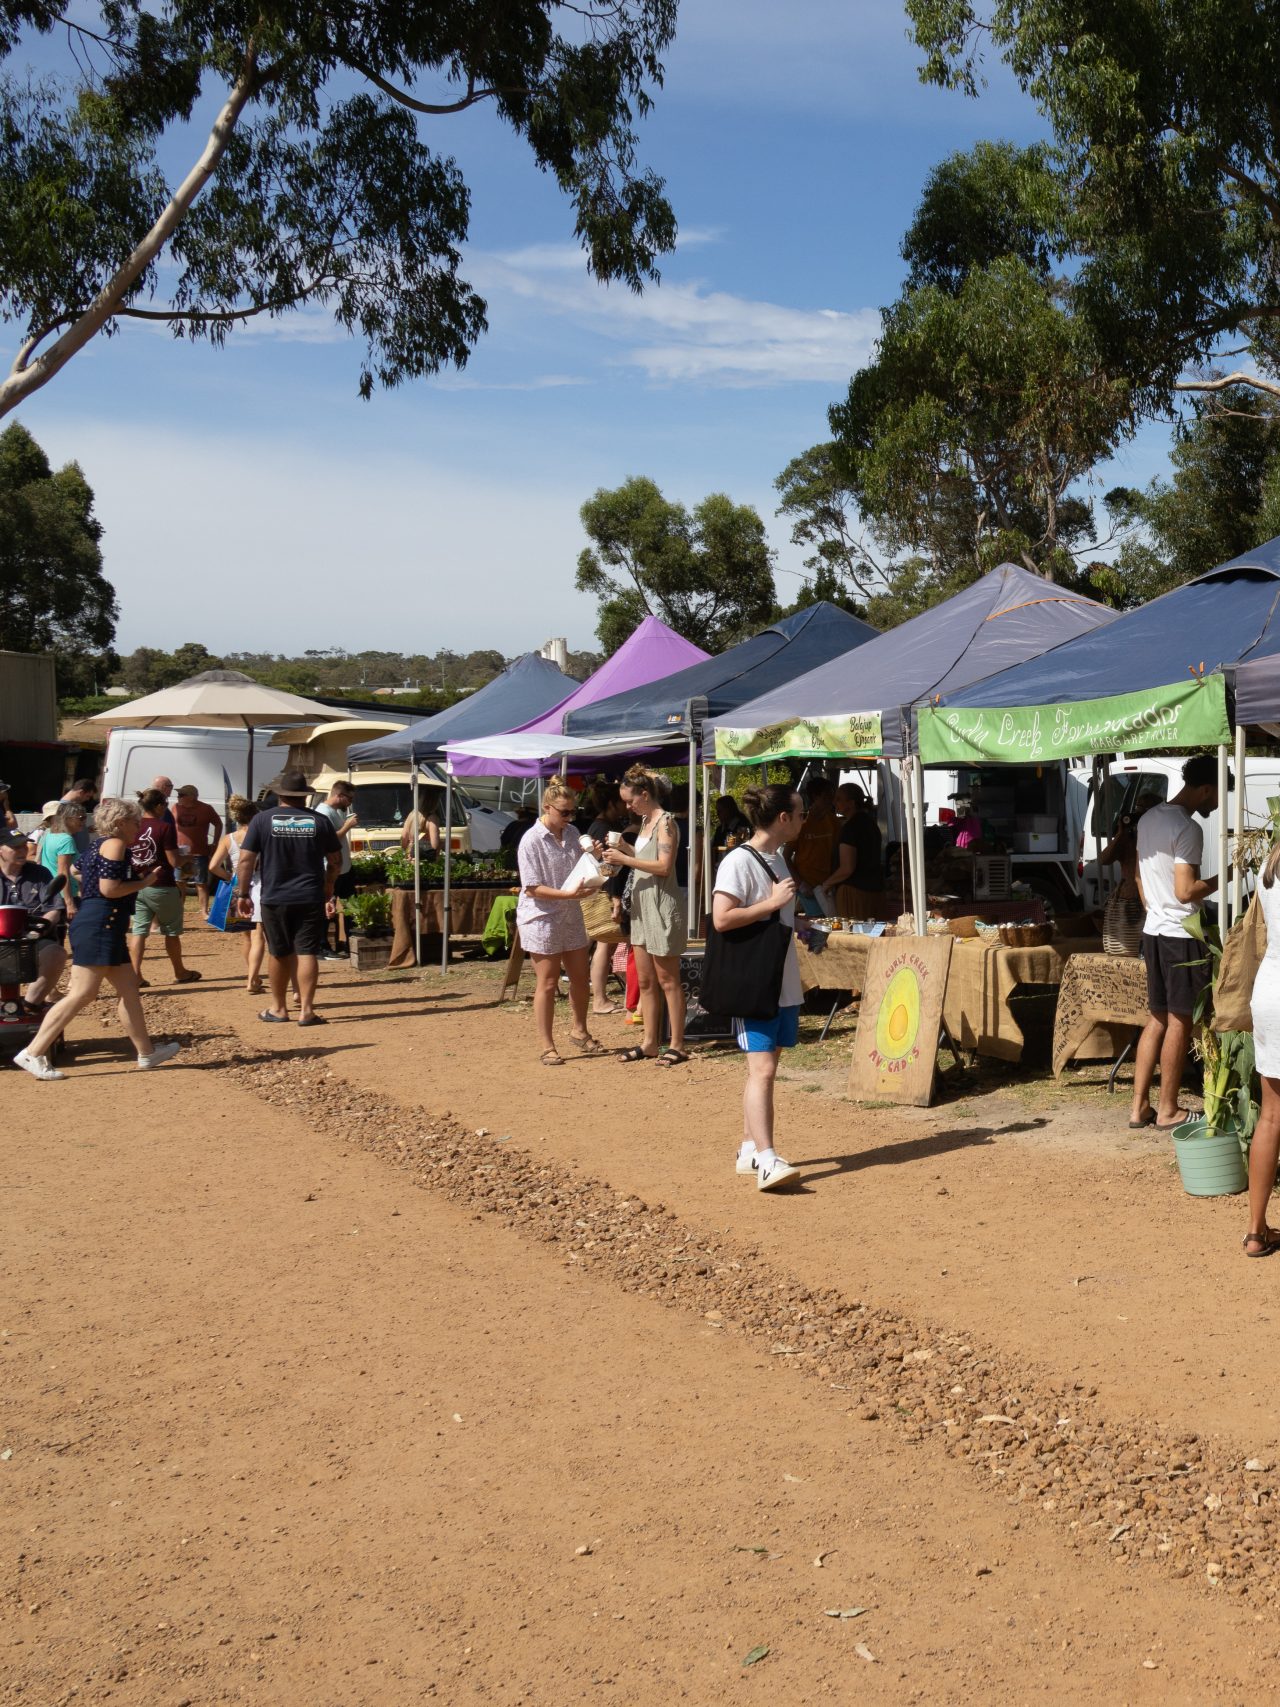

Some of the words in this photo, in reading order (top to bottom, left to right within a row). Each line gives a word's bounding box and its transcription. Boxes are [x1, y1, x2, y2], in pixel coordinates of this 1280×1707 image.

[998, 711, 1043, 759] Creek
[1090, 731, 1150, 749] MARGARET
[885, 953, 907, 979] CURLY
[909, 953, 930, 981] CREEK
[868, 1046, 920, 1073] AVOCADOS
